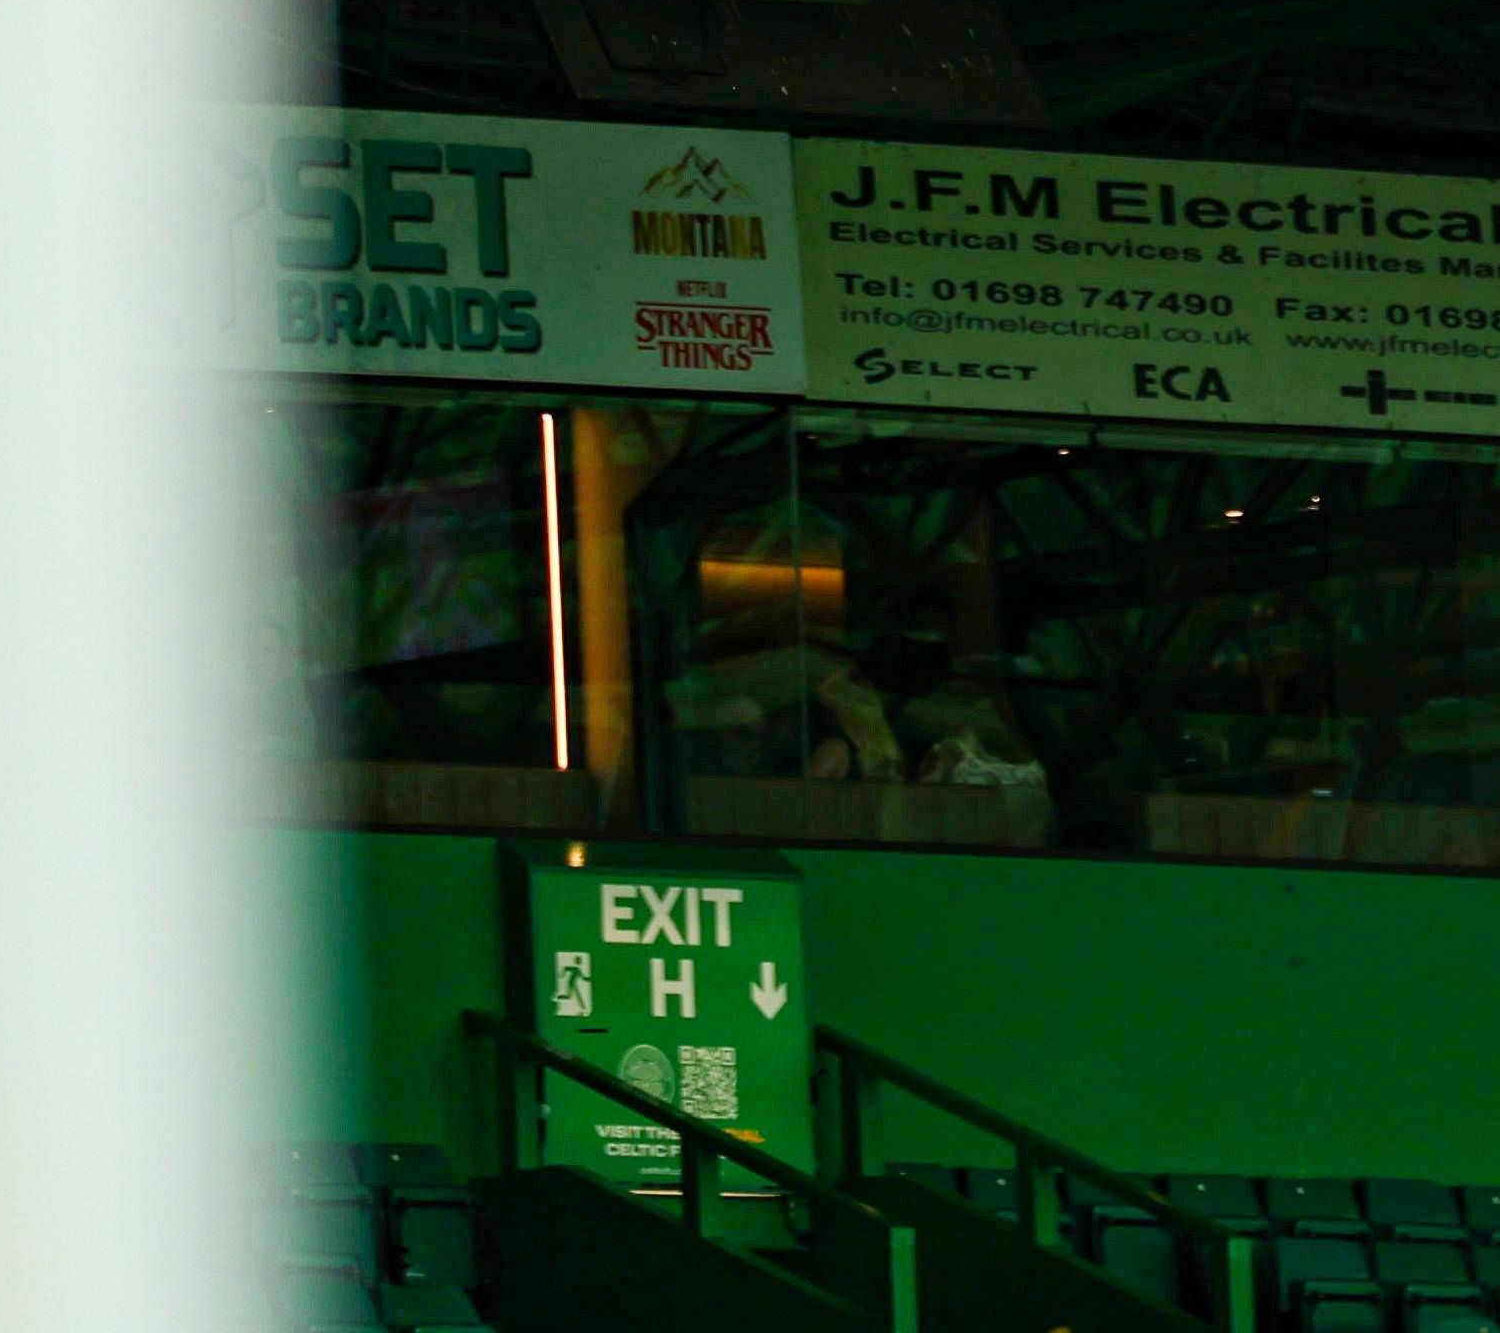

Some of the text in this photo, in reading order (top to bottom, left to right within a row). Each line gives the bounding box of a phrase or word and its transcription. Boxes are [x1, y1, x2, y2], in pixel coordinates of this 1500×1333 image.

[829, 165, 1061, 221] J.F.M
[632, 209, 768, 262] MONTANA
[829, 220, 1019, 253] Electrical
[1033, 233, 1203, 264] Services
[1216, 244, 1245, 266] &
[278, 279, 543, 355] BRANDS
[836, 272, 1234, 319] Tel: 01698 747490
[1275, 297, 1368, 324] Fax:
[634, 306, 774, 350] STRANGER
[840, 304, 1253, 347] info@jfmelectrical.co.uk
[657, 339, 755, 372] THINGS
[853, 347, 1040, 385] SELECT
[1132, 362, 1232, 403] ECA
[602, 884, 744, 948] EXIT
[651, 958, 697, 1019] H
[594, 1124, 644, 1140] VISIT
[603, 1142, 669, 1158] CELTIC
